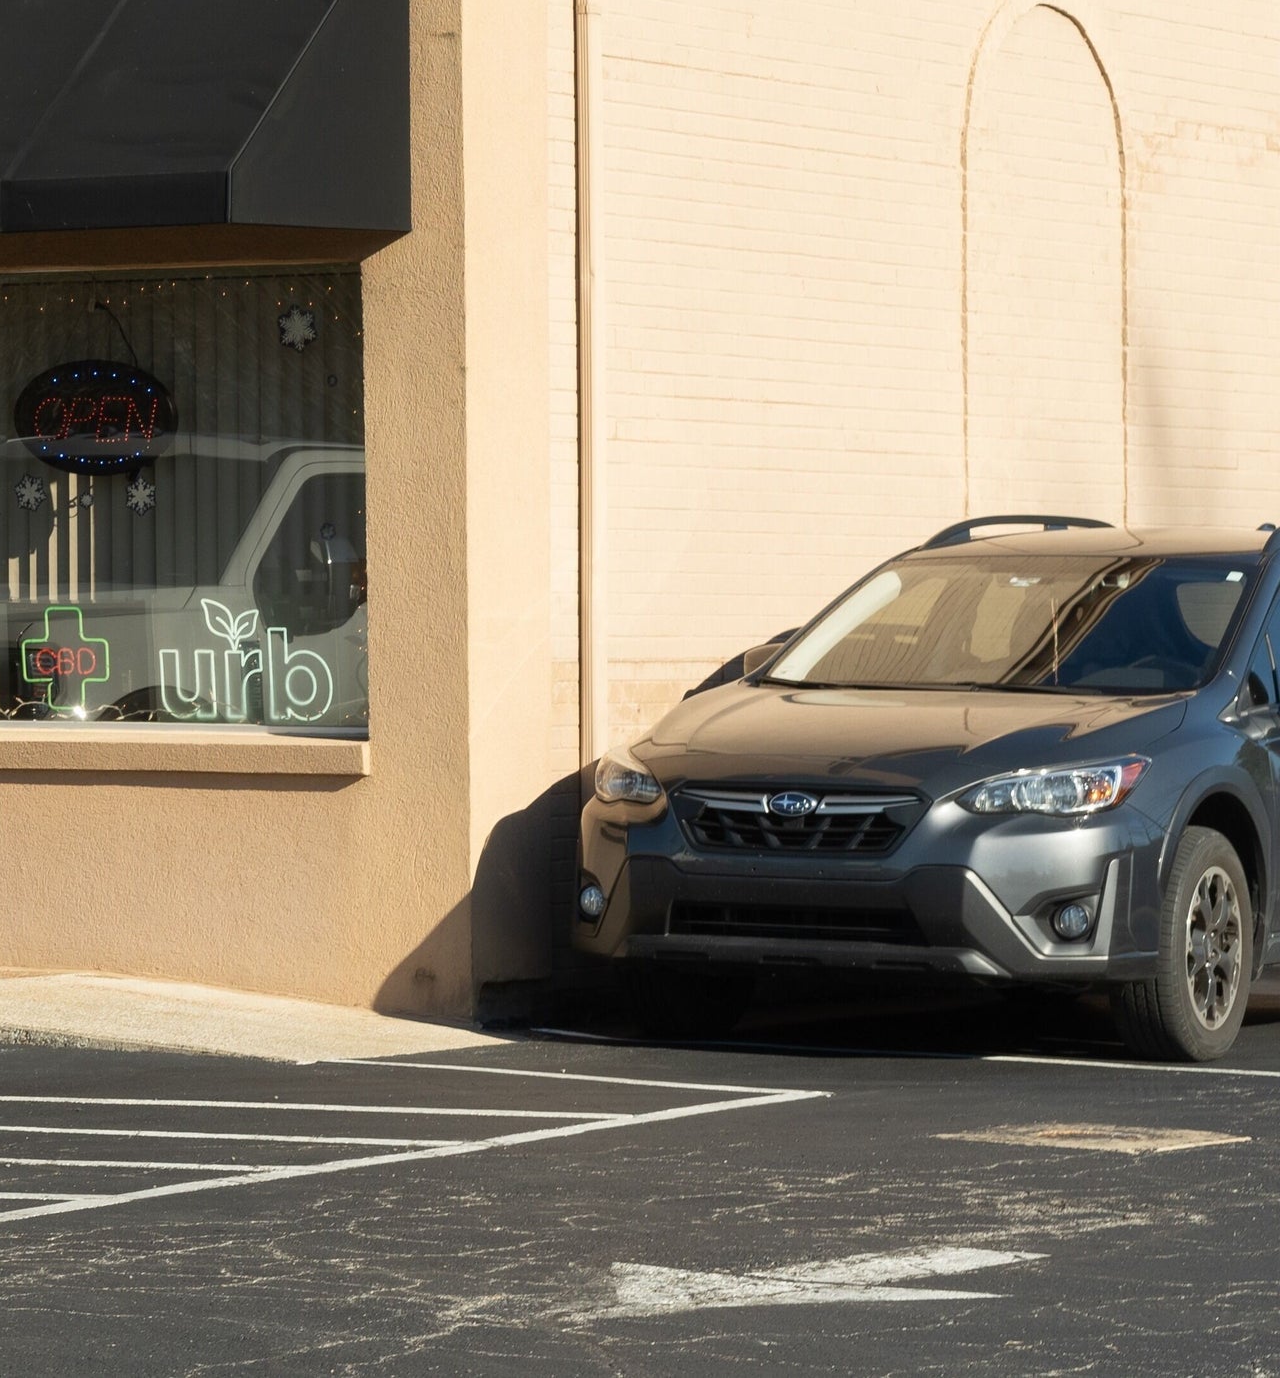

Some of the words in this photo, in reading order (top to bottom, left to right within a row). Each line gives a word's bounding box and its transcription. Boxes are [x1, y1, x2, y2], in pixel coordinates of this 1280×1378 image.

[34, 396, 158, 443] OPEN
[36, 646, 96, 676] CBD
[158, 627, 333, 722] urb
